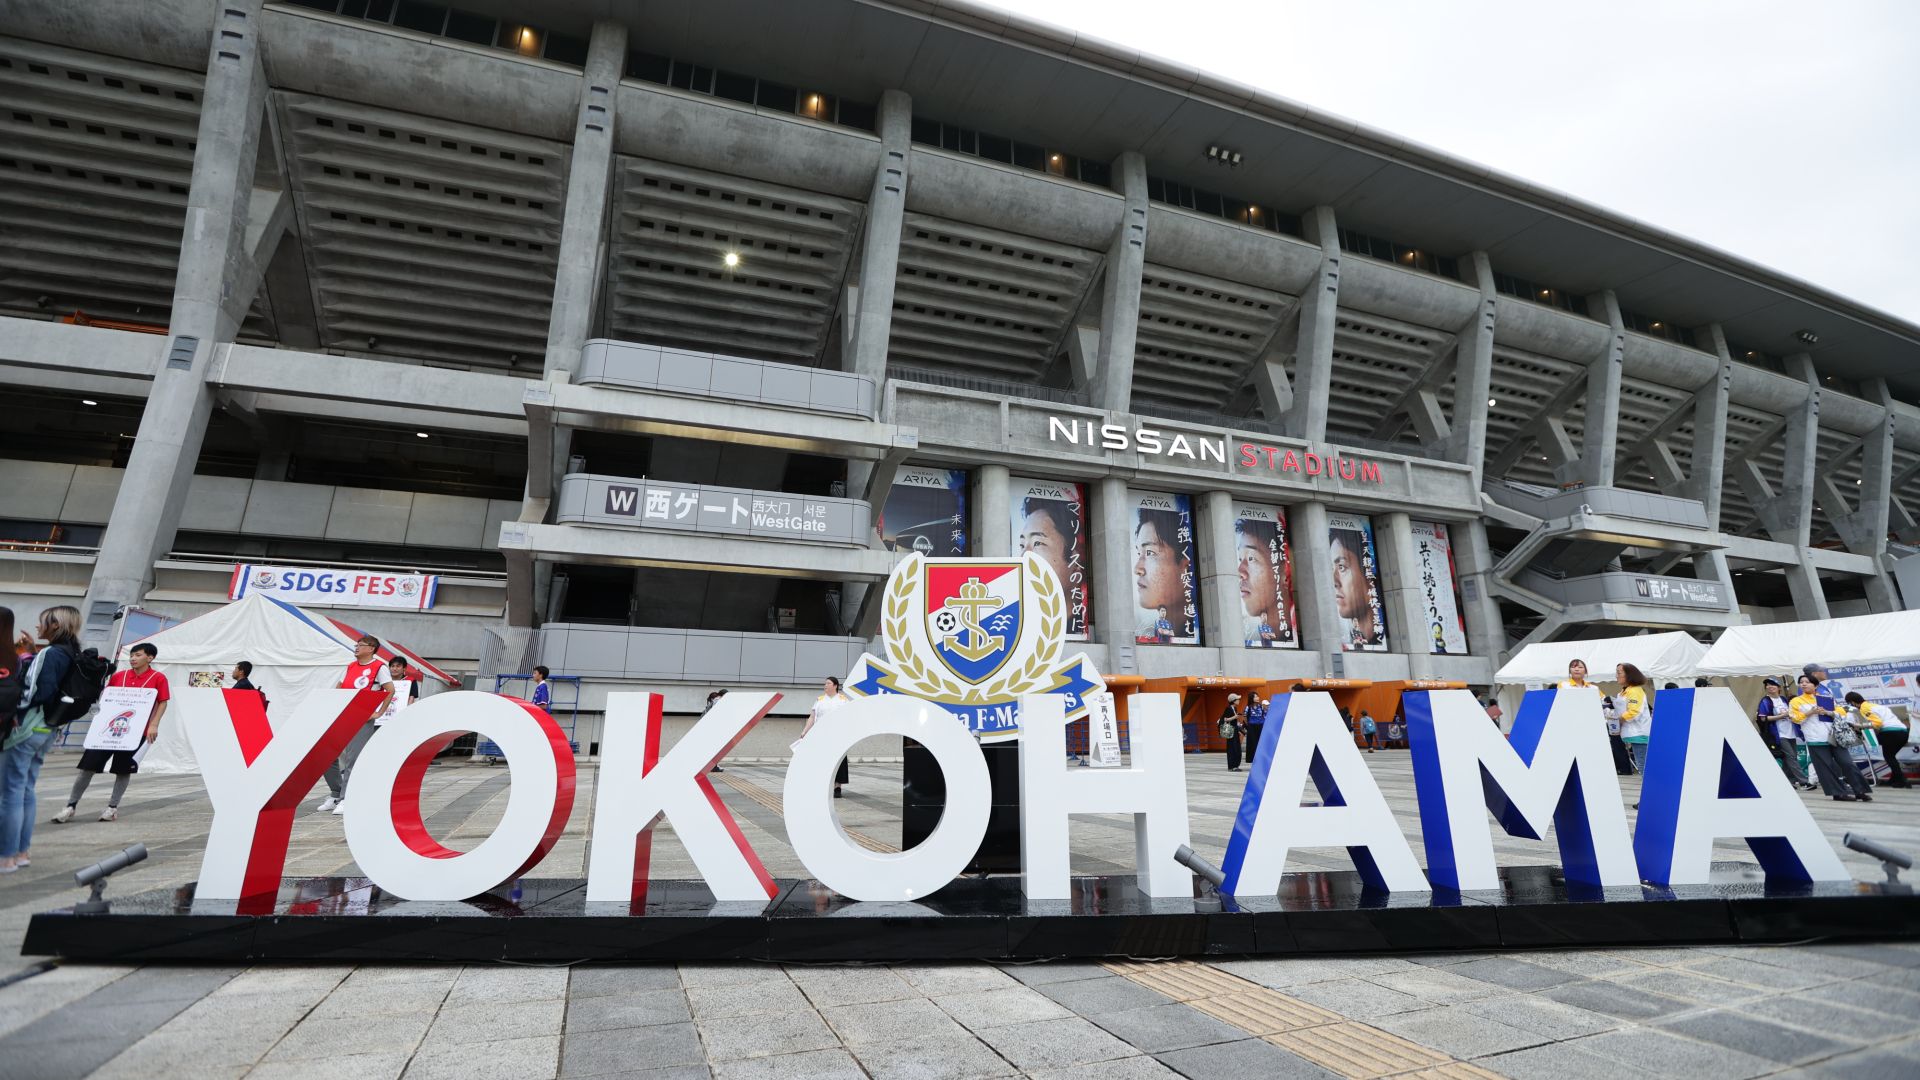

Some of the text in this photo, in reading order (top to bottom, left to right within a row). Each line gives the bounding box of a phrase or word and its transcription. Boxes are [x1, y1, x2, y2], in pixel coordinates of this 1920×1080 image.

[1049, 416, 1384, 485] NISSAN STADIUM
[903, 475, 941, 486] ARIYA
[609, 489, 636, 512] W
[1028, 487, 1062, 498] ARIYA
[644, 489, 749, 525] 西ゲート
[752, 499, 791, 516] 西大门
[803, 504, 826, 519] 서문
[1140, 499, 1171, 509] ARIYA
[1240, 509, 1268, 519] ARIYA
[951, 513, 962, 553] 未来へ
[1330, 519, 1355, 529] ARIYA
[1411, 527, 1434, 536] ARIYA
[1067, 501, 1087, 632] マリノスのために
[280, 571, 347, 593] SDGs
[353, 575, 396, 596] FES
[1637, 580, 1648, 595] W
[1649, 580, 1689, 601] 西ゲート
[1100, 705, 1112, 739] 再入場口
[171, 686, 1853, 910] YOKOHAMA
